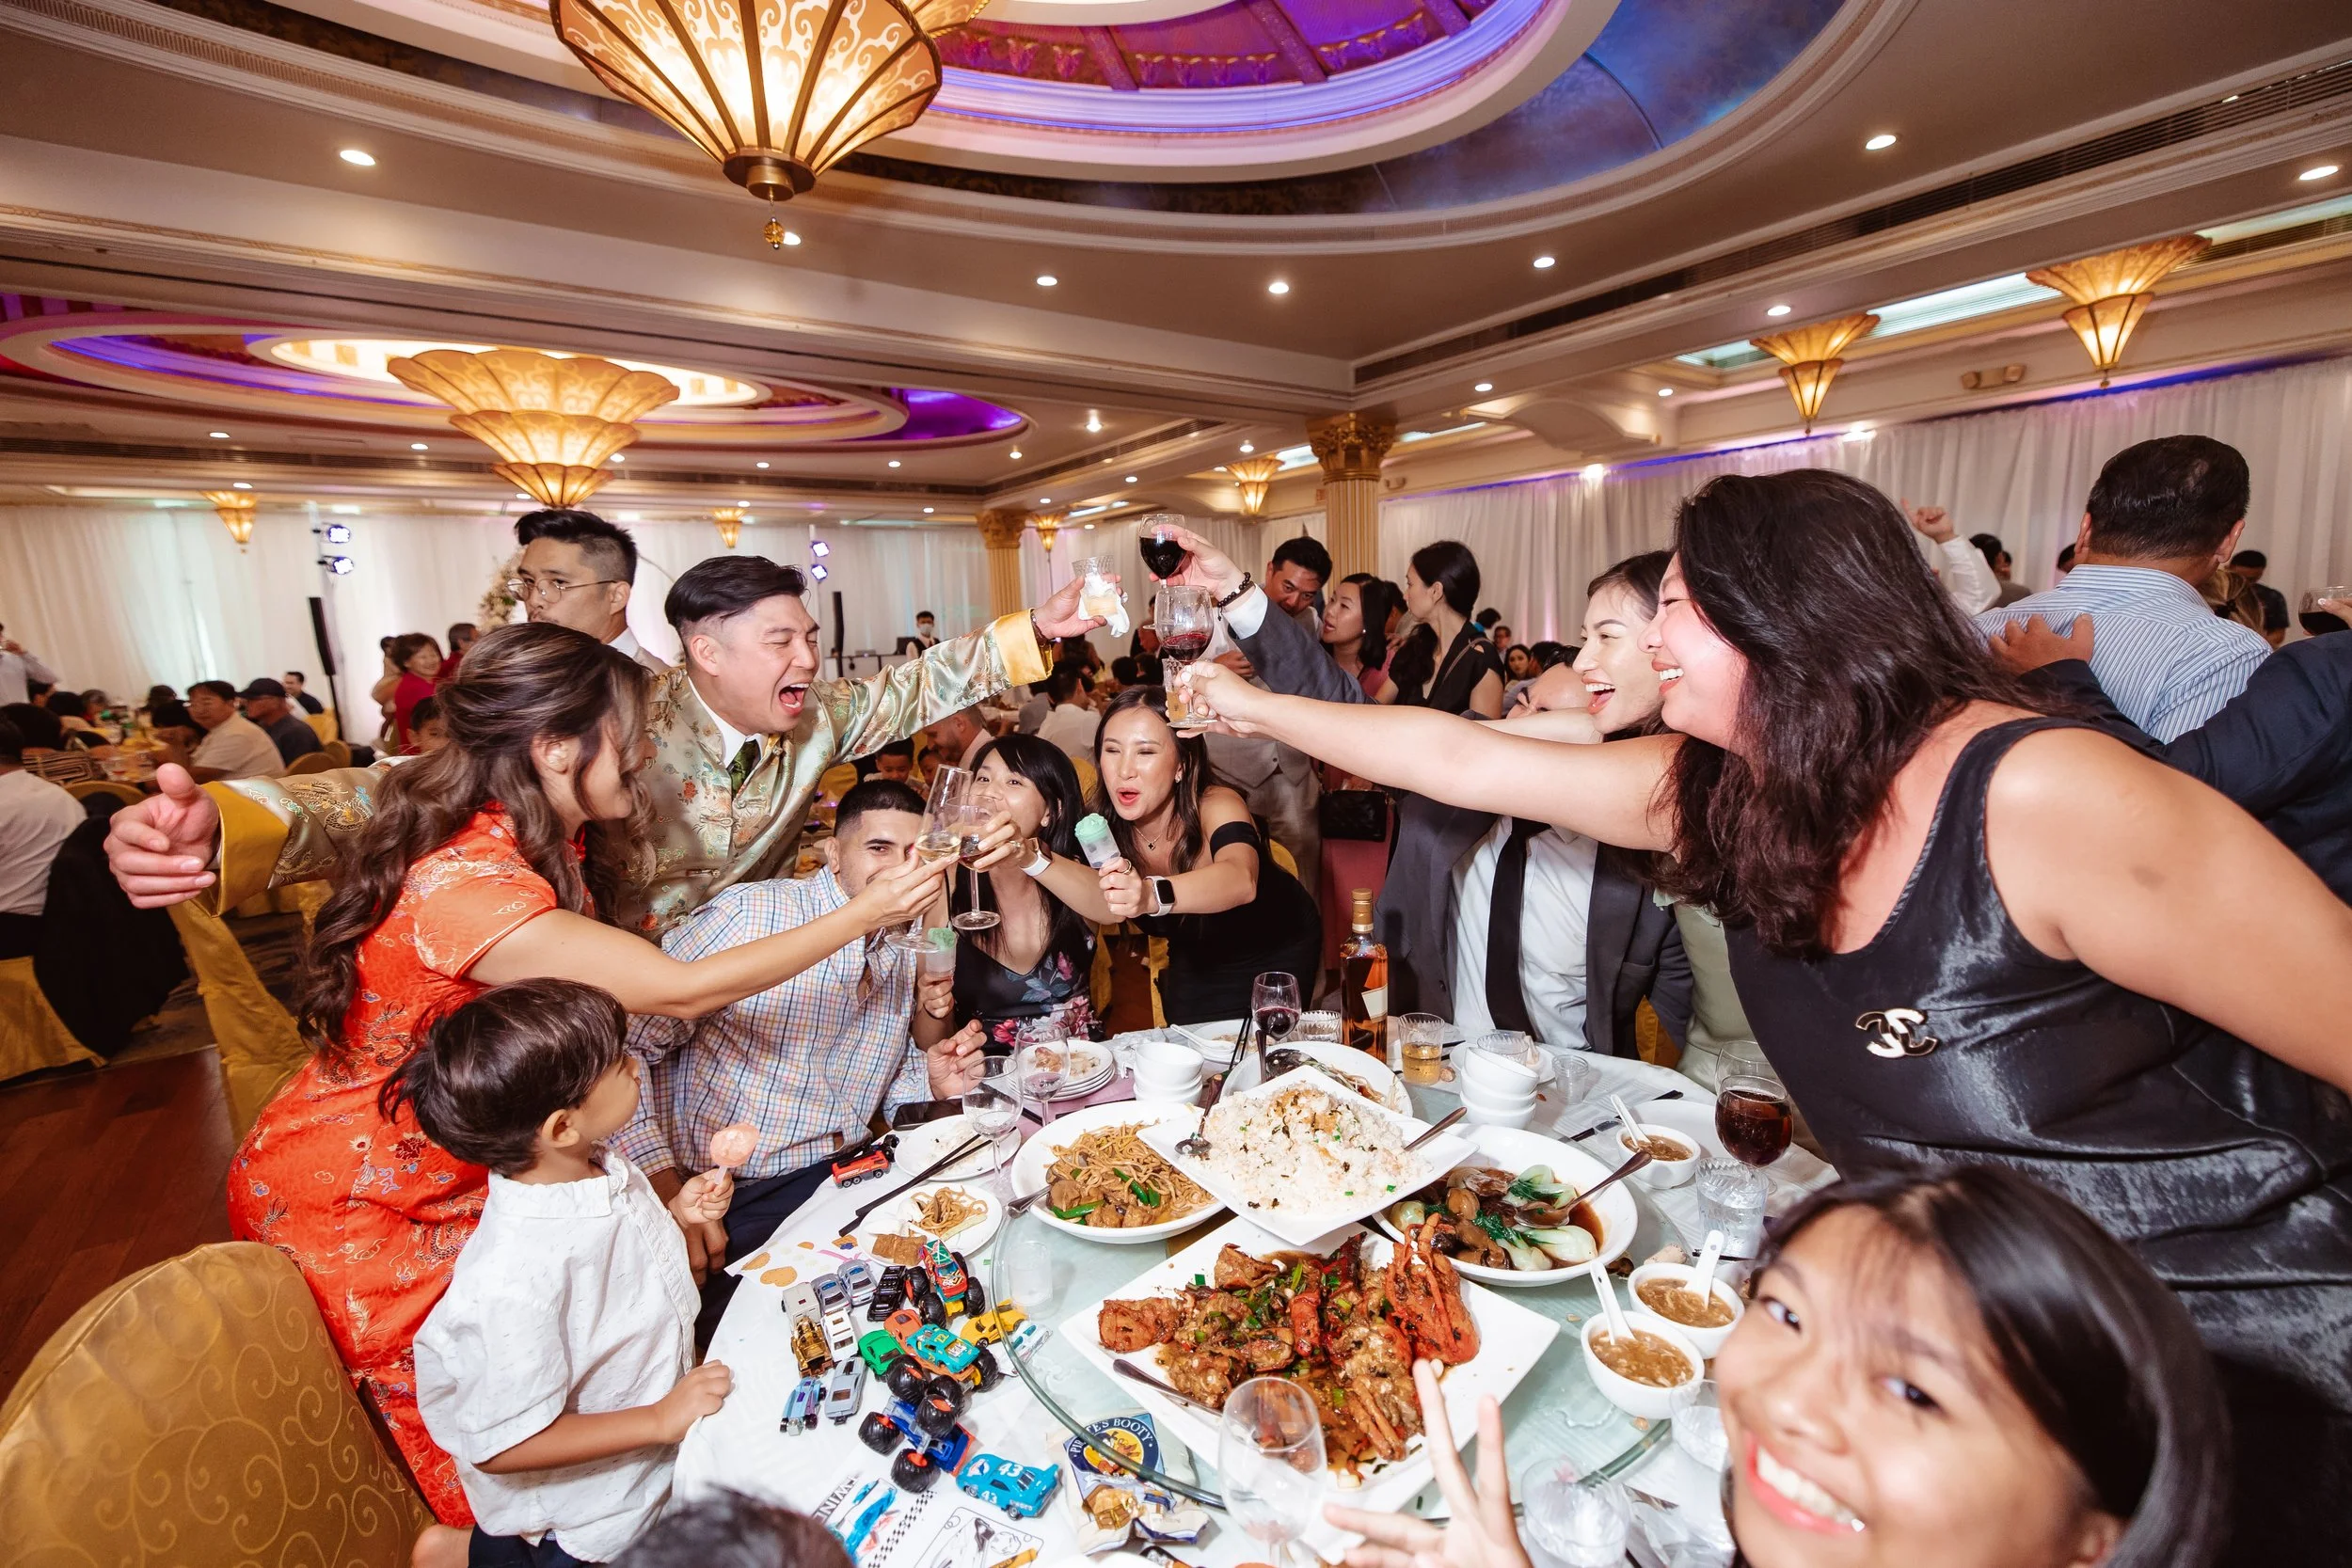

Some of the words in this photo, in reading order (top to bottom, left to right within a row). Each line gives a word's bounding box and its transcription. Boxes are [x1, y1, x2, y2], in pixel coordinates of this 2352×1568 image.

[1070, 1419, 1110, 1453] PIRTE'S
[1113, 1418, 1153, 1442] BOOTY
[998, 1462, 1025, 1478] 43
[981, 1490, 997, 1504] 43
